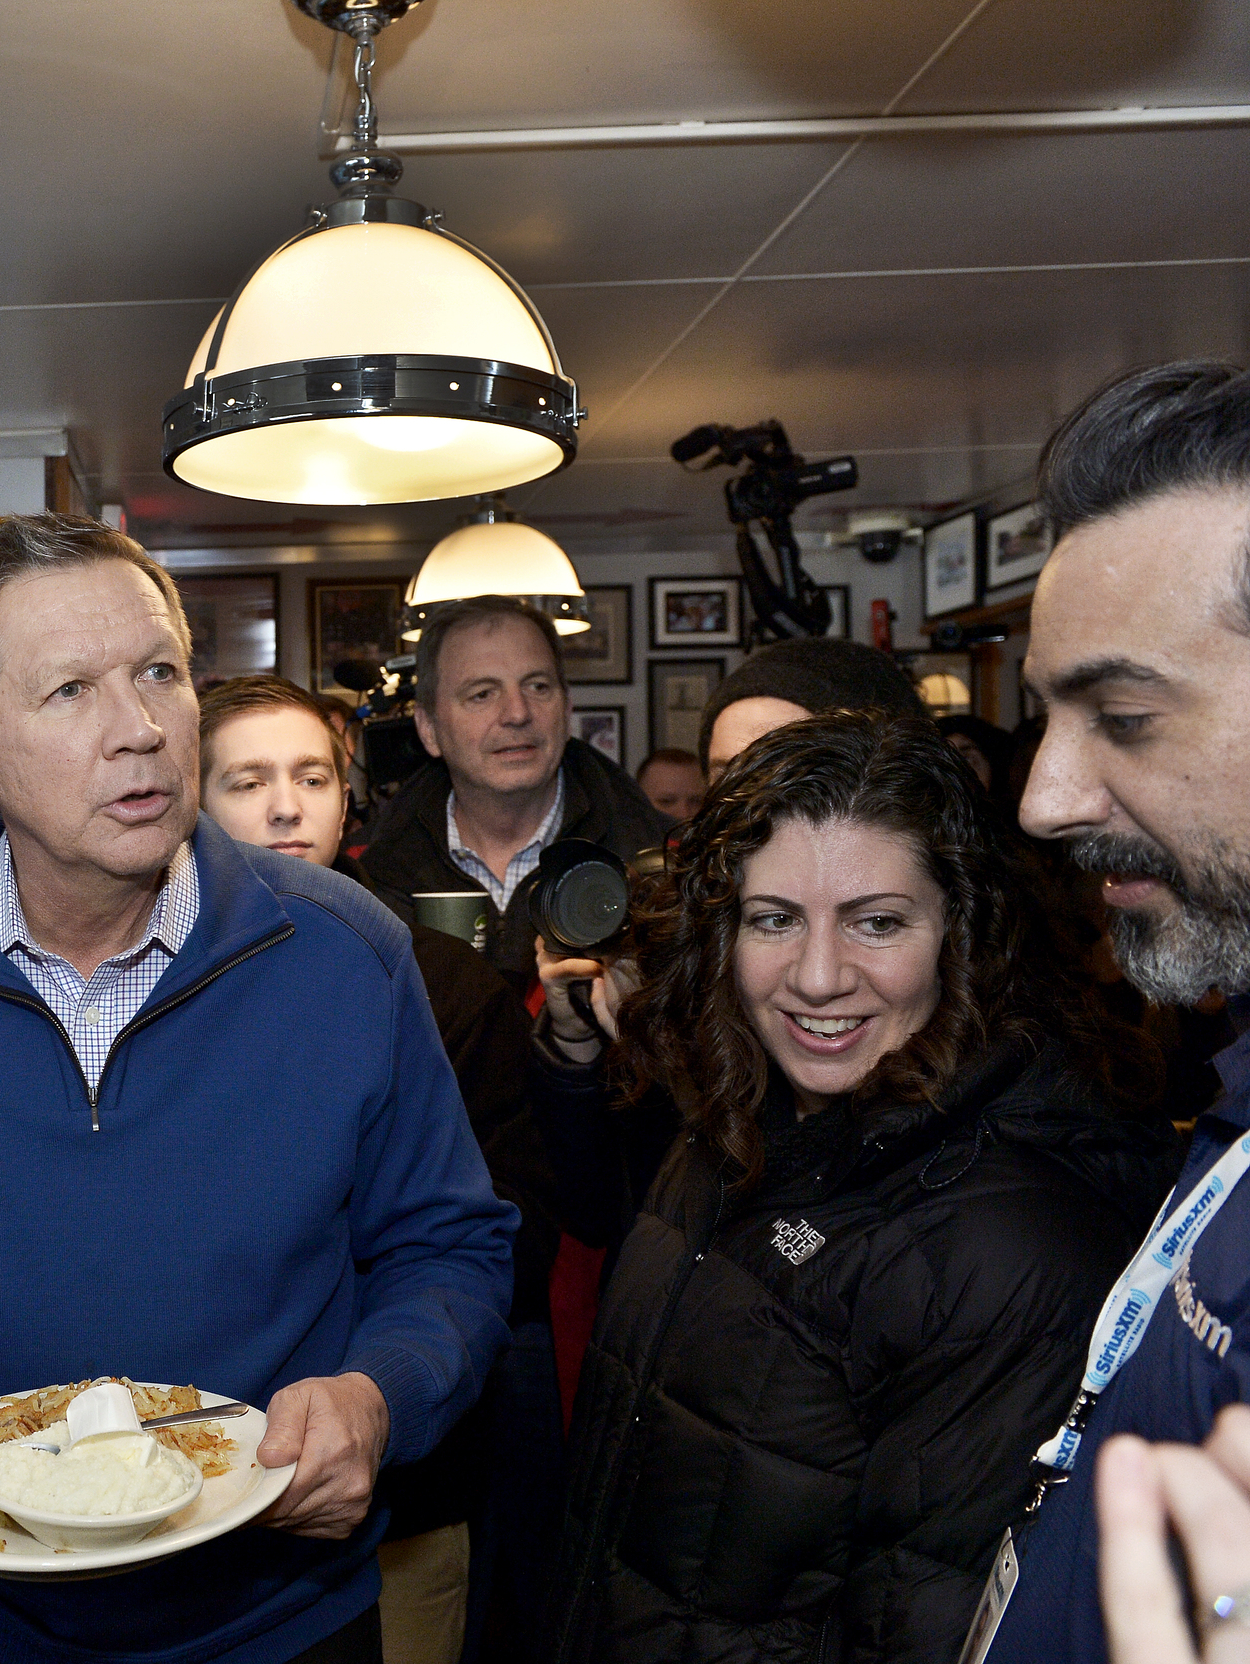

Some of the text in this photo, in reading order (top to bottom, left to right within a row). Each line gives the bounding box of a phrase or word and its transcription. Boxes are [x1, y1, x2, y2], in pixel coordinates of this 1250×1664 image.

[772, 1218, 810, 1253] NORTH
[796, 1219, 820, 1244] THE
[771, 1234, 800, 1262] FACE
[1116, 1335, 1135, 1368] SATELLITE
